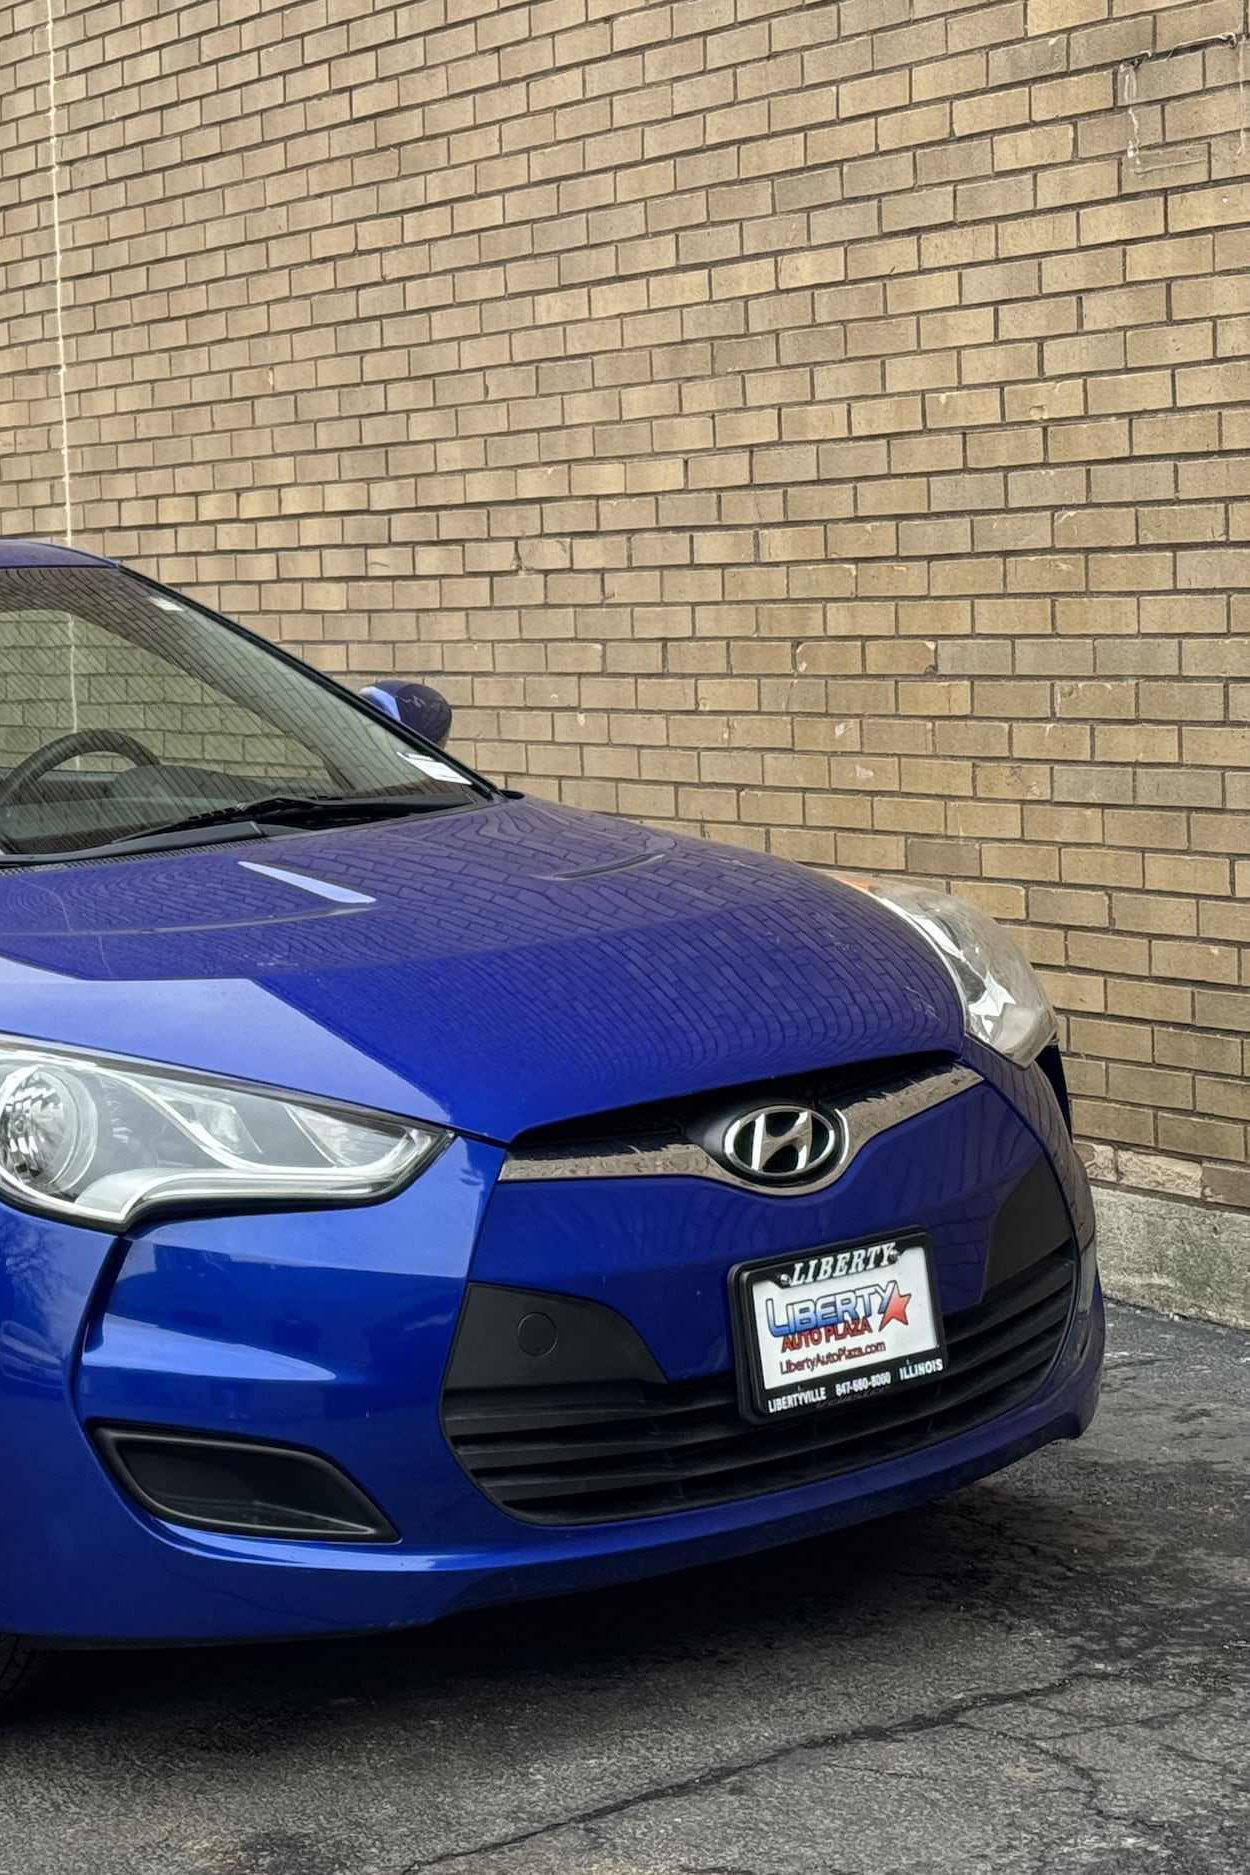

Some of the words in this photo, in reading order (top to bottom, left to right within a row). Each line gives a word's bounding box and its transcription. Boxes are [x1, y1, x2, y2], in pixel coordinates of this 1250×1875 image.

[791, 1241, 897, 1286] LIBERTY
[766, 1280, 897, 1338] LIBERTY
[780, 1341, 886, 1375] LibertyAutoPlaza.com
[781, 1327, 823, 1353] AUTO
[825, 1318, 872, 1342] PLAZA
[768, 1387, 827, 1413] LIBERTYVILLE
[899, 1358, 944, 1381] ILLINOIS
